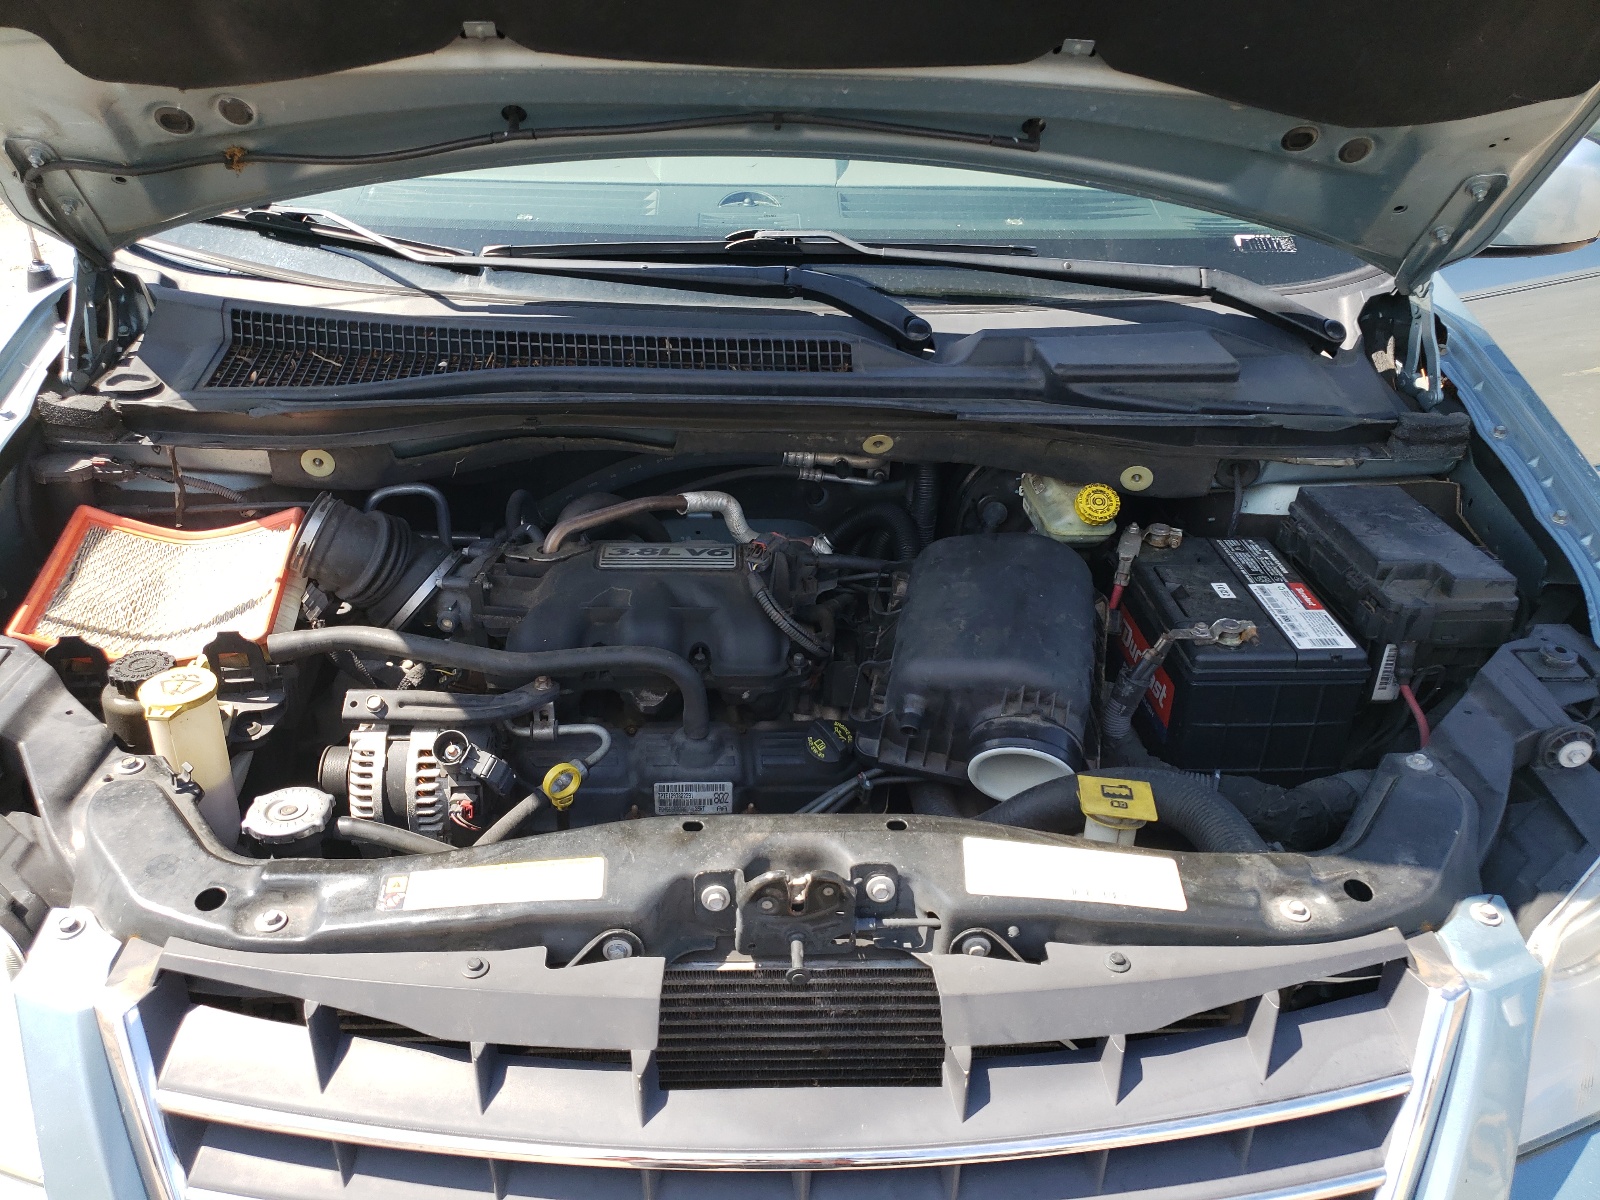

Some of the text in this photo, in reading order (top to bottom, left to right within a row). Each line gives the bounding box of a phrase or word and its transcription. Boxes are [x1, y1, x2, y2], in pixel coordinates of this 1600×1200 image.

[608, 547, 729, 557] 3.8L V6
[1120, 618, 1167, 709] Durast
[713, 792, 729, 804] 802
